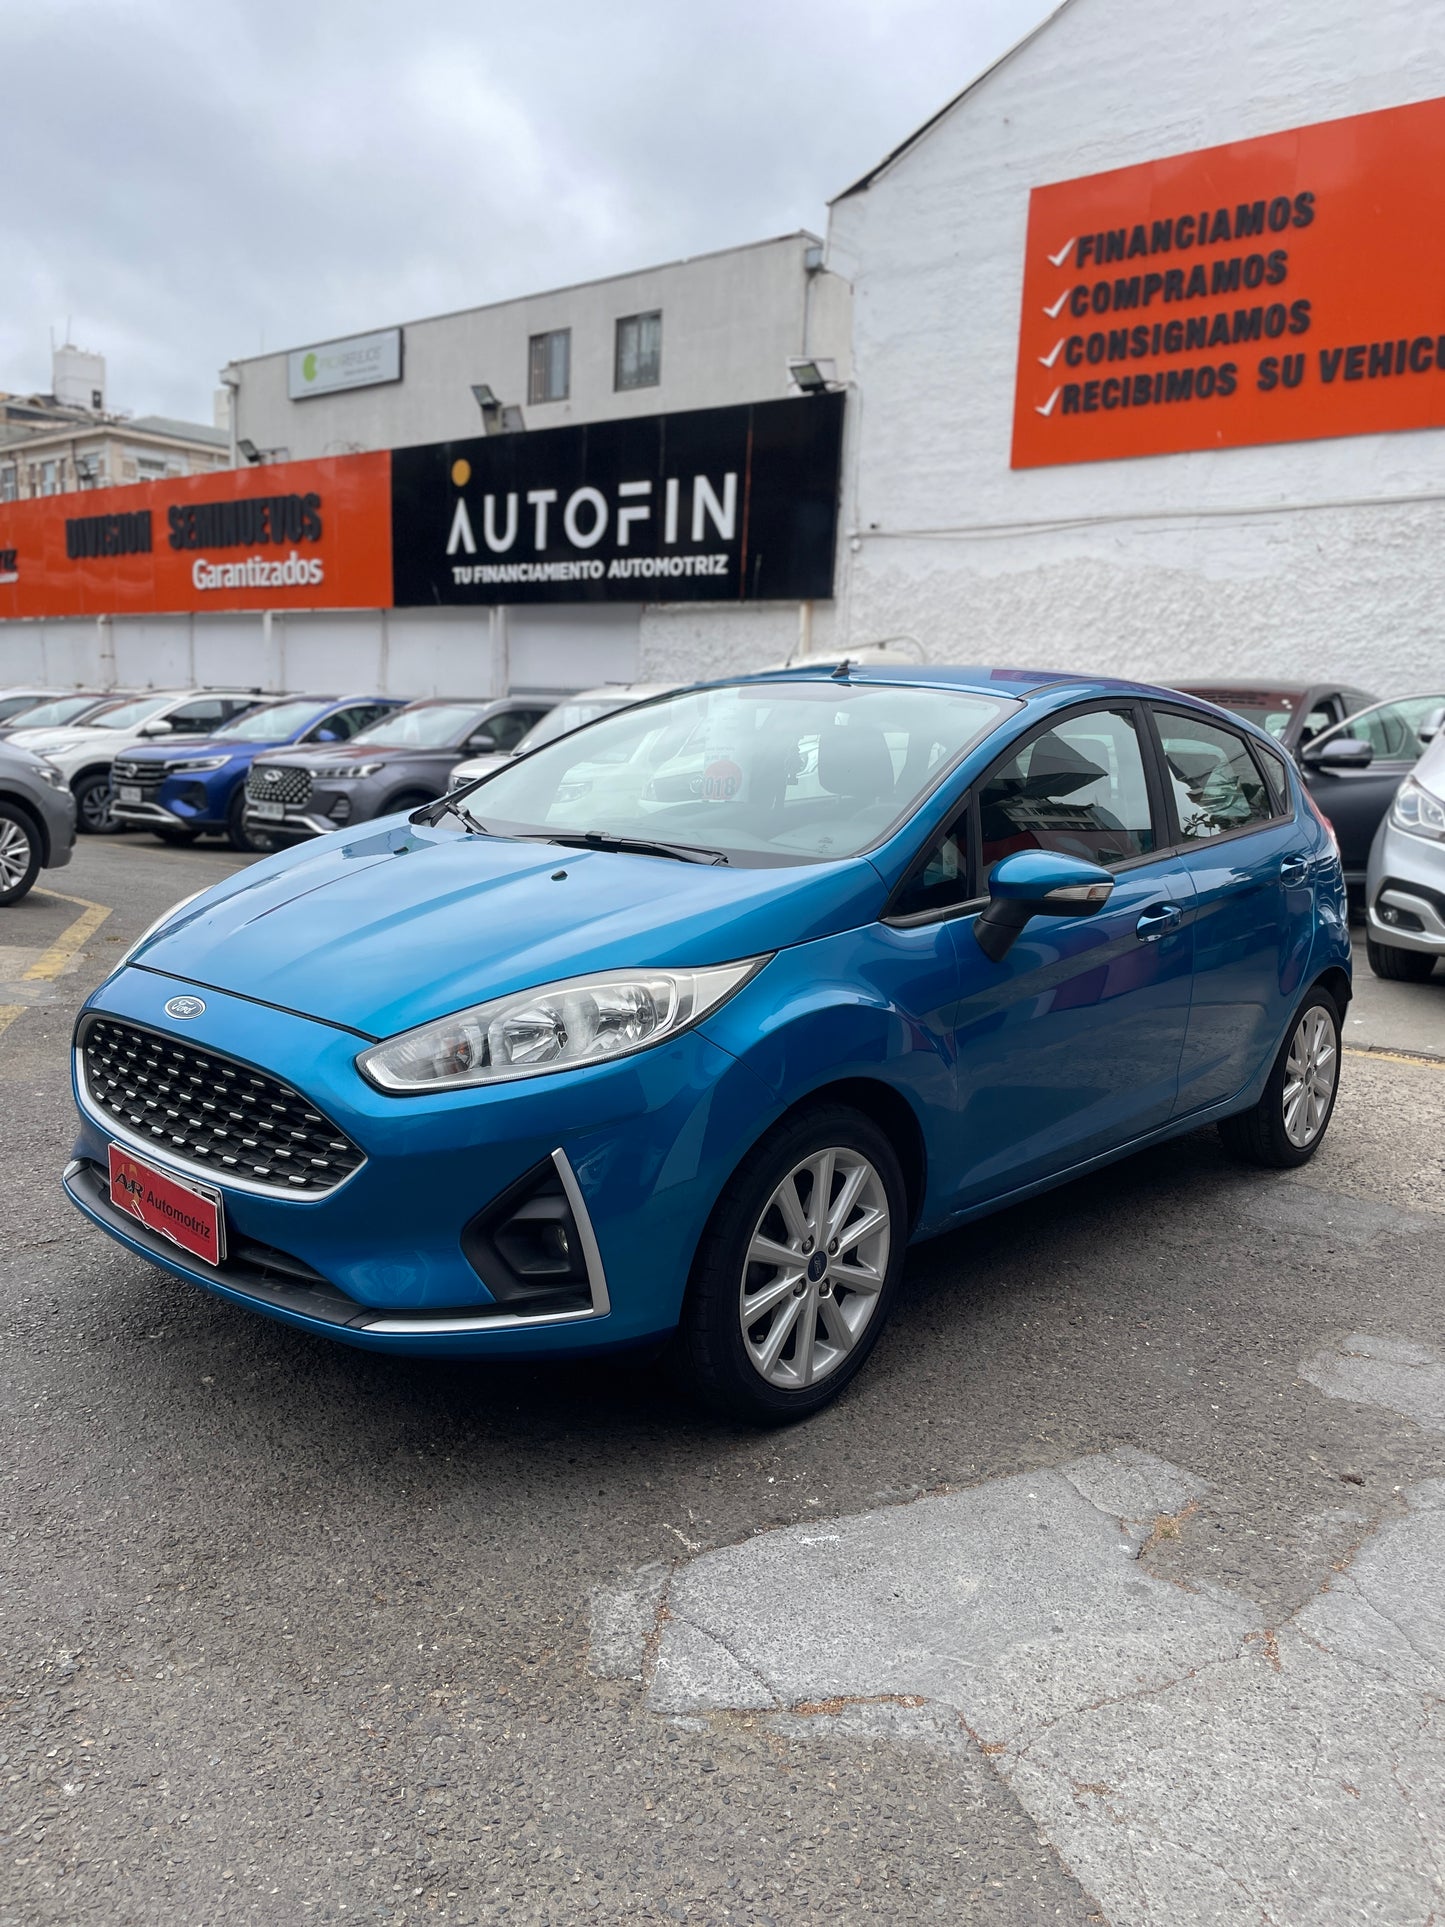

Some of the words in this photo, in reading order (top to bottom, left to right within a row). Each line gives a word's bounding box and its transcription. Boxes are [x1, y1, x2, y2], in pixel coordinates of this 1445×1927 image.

[1076, 192, 1315, 268] FINANCIAMOS
[1070, 249, 1288, 317] COMPRAMOS
[1065, 299, 1311, 366] CONSIGNAMOS
[1061, 362, 1237, 415] RECIBIMOS
[1257, 354, 1305, 391] SU
[446, 473, 737, 555] AUTOFIN
[192, 551, 323, 590] Garantizados
[452, 565, 472, 585] TU
[473, 559, 604, 584] FINANCIAMIENTO
[608, 554, 729, 579] AUTOMOTRIZ
[146, 1190, 211, 1239] Automotriz
